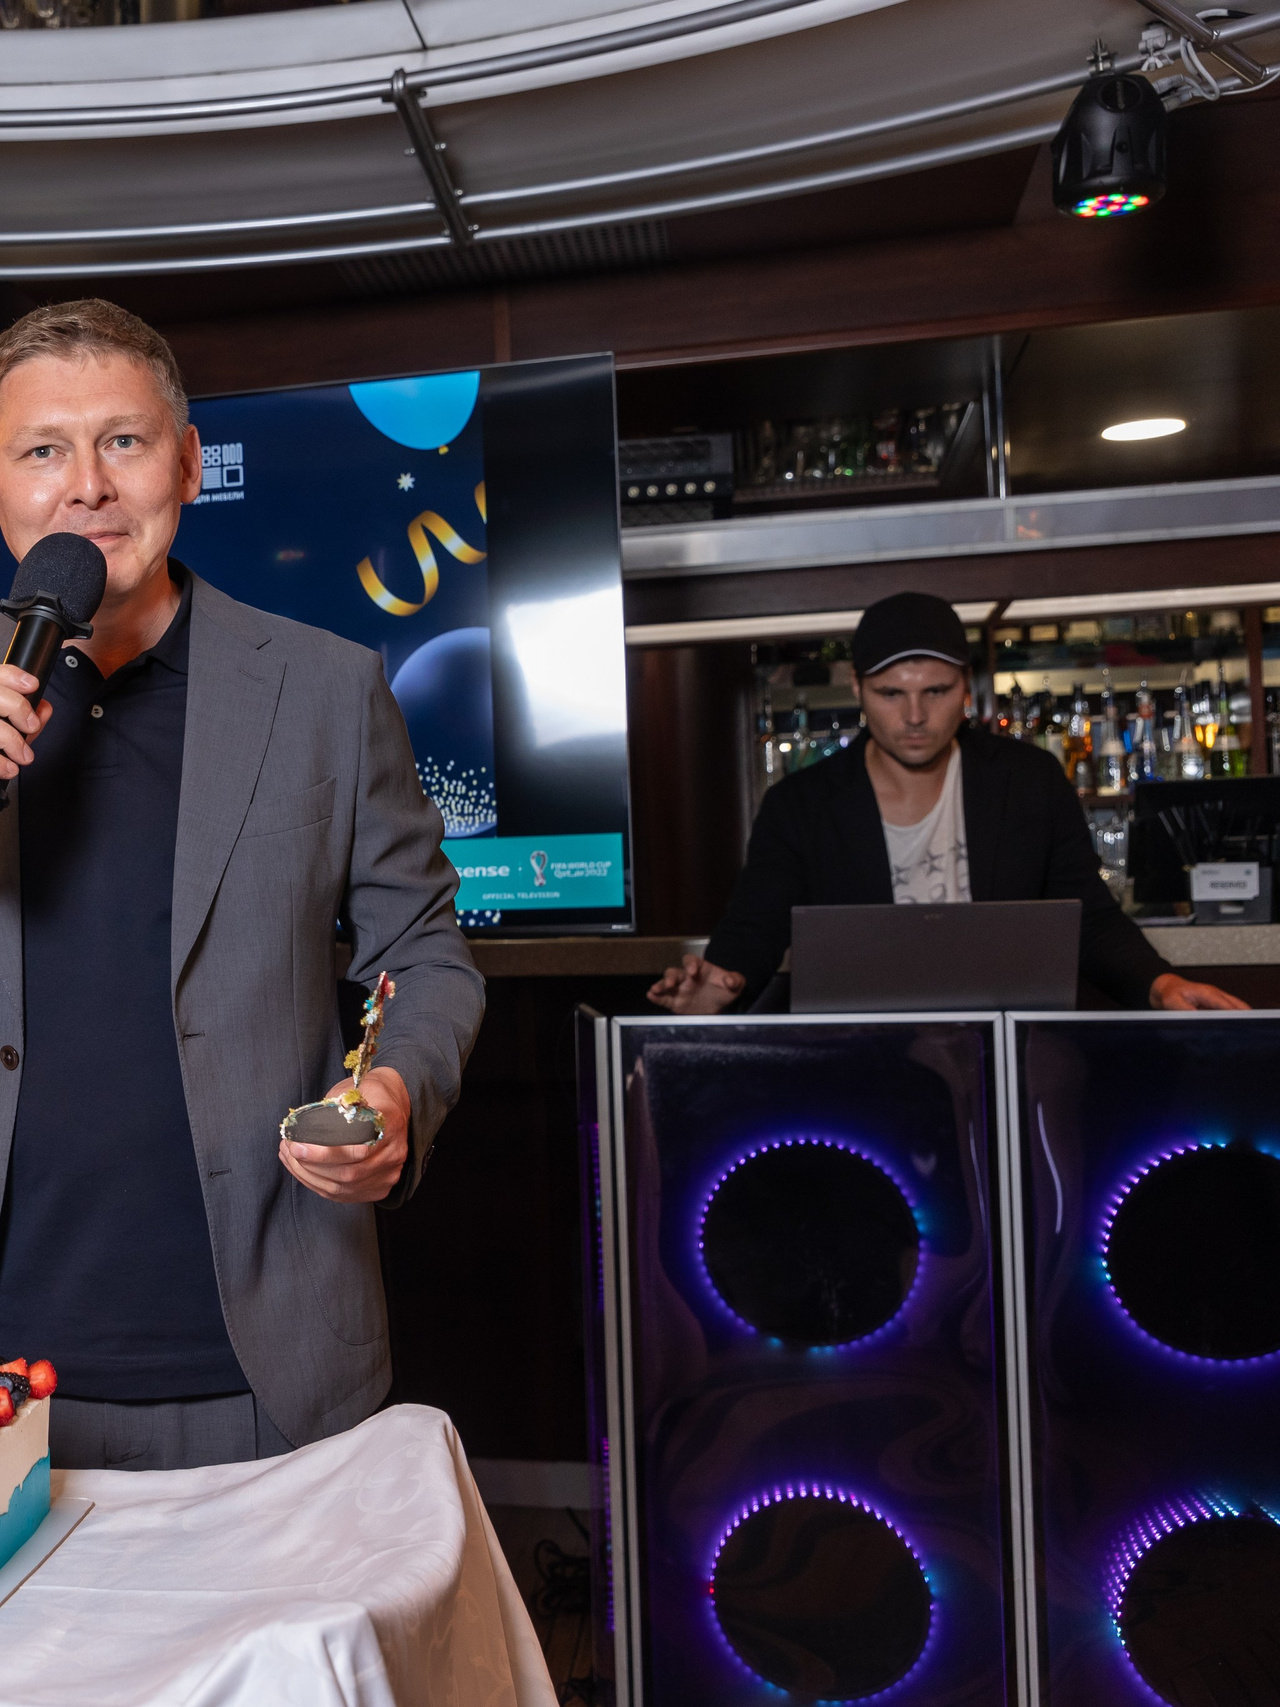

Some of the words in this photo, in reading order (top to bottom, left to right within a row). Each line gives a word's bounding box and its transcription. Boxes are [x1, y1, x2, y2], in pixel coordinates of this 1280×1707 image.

[211, 491, 245, 502] МЕБЕЛИ
[551, 862, 567, 870] FIFA
[568, 861, 595, 870] WORLD
[596, 860, 612, 869] CUP
[454, 865, 510, 878] sense
[482, 892, 515, 900] OFFICIAL
[517, 891, 560, 899] TELEVISION
